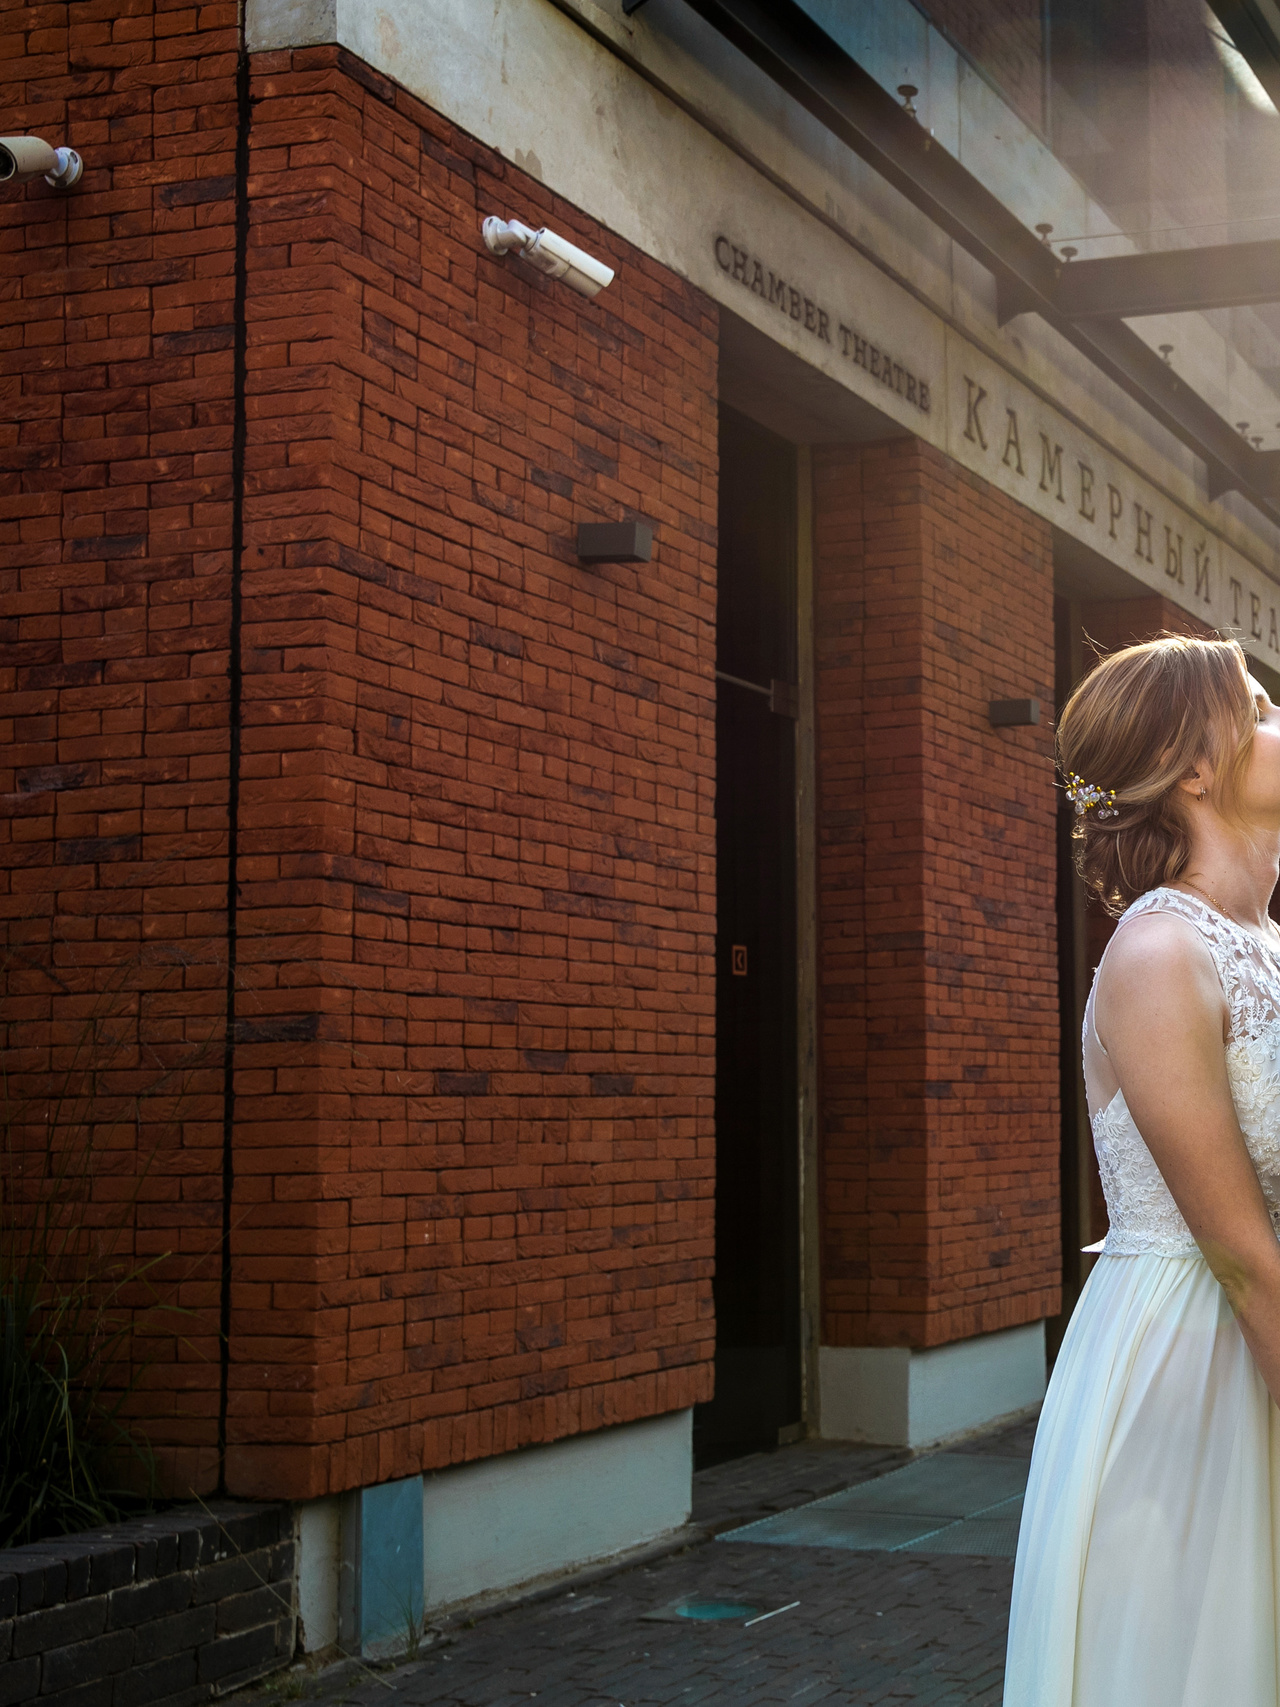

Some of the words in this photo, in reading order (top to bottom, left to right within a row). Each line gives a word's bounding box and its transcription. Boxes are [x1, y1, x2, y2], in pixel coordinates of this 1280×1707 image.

[714, 235, 831, 344] CHAMBER
[838, 323, 931, 413] THEATRE
[963, 375, 1211, 604] КАМЕРНЫЙ
